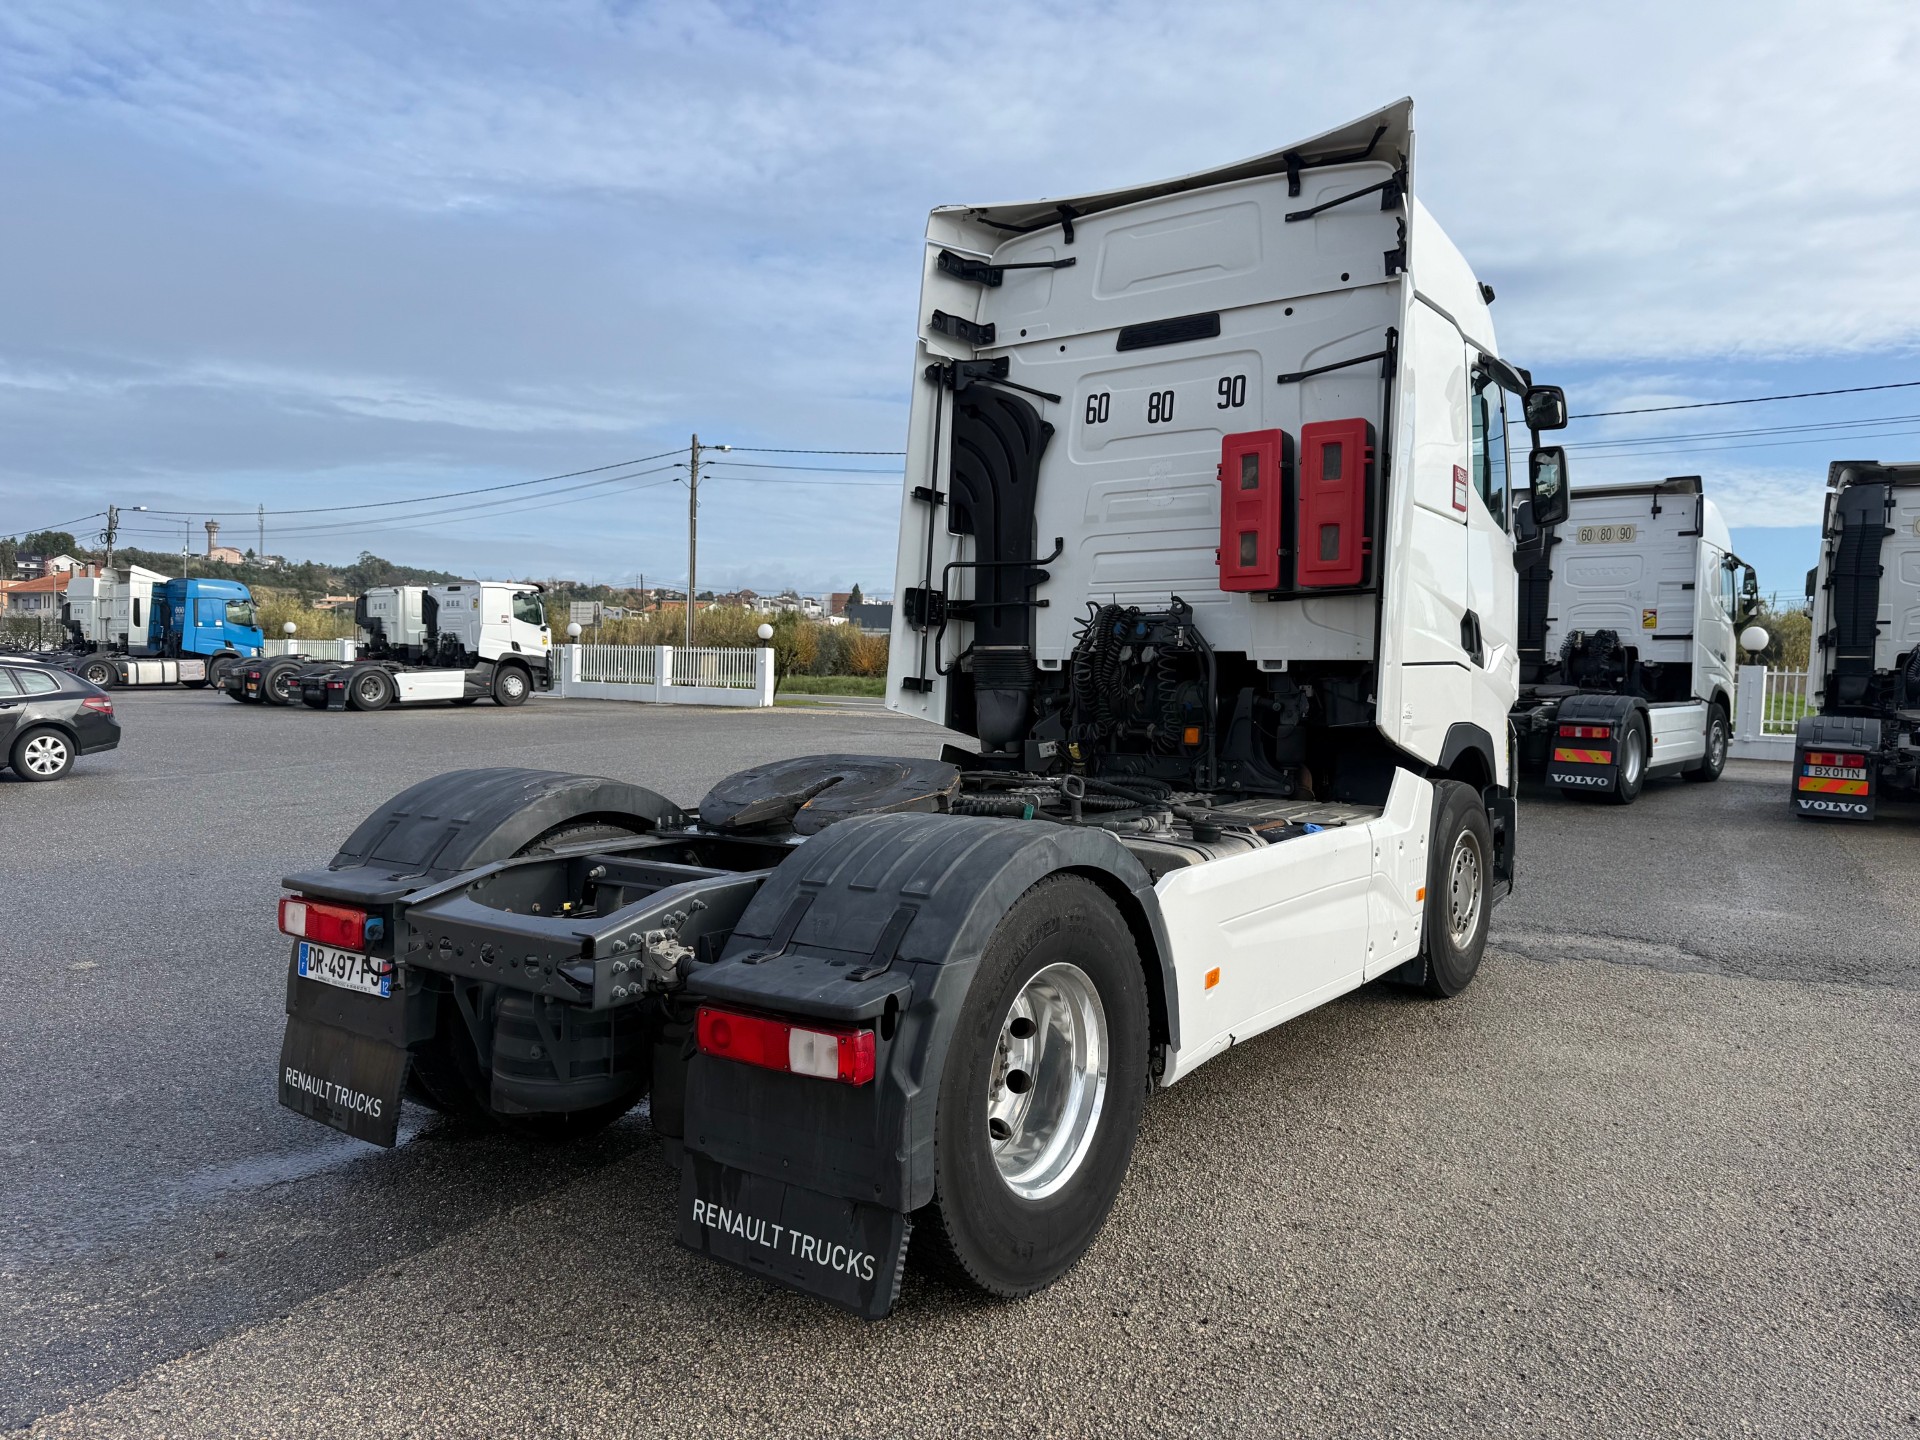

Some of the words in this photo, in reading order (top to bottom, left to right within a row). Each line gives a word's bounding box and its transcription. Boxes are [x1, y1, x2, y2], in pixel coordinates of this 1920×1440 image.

[1086, 392, 1111, 424] 60
[1147, 390, 1175, 423] 80
[1217, 374, 1247, 410] 90
[1581, 528, 1593, 542] 60
[1600, 527, 1612, 541] 80
[1620, 526, 1632, 540] 90
[1551, 773, 1609, 786] VOLVO
[1797, 799, 1868, 814] VOLVO
[382, 981, 389, 994] 12
[285, 1066, 333, 1100] RENAULT
[334, 1084, 383, 1118] TRUCKS
[692, 1198, 784, 1250] RENAULT
[789, 1229, 876, 1281] TRUCKS
